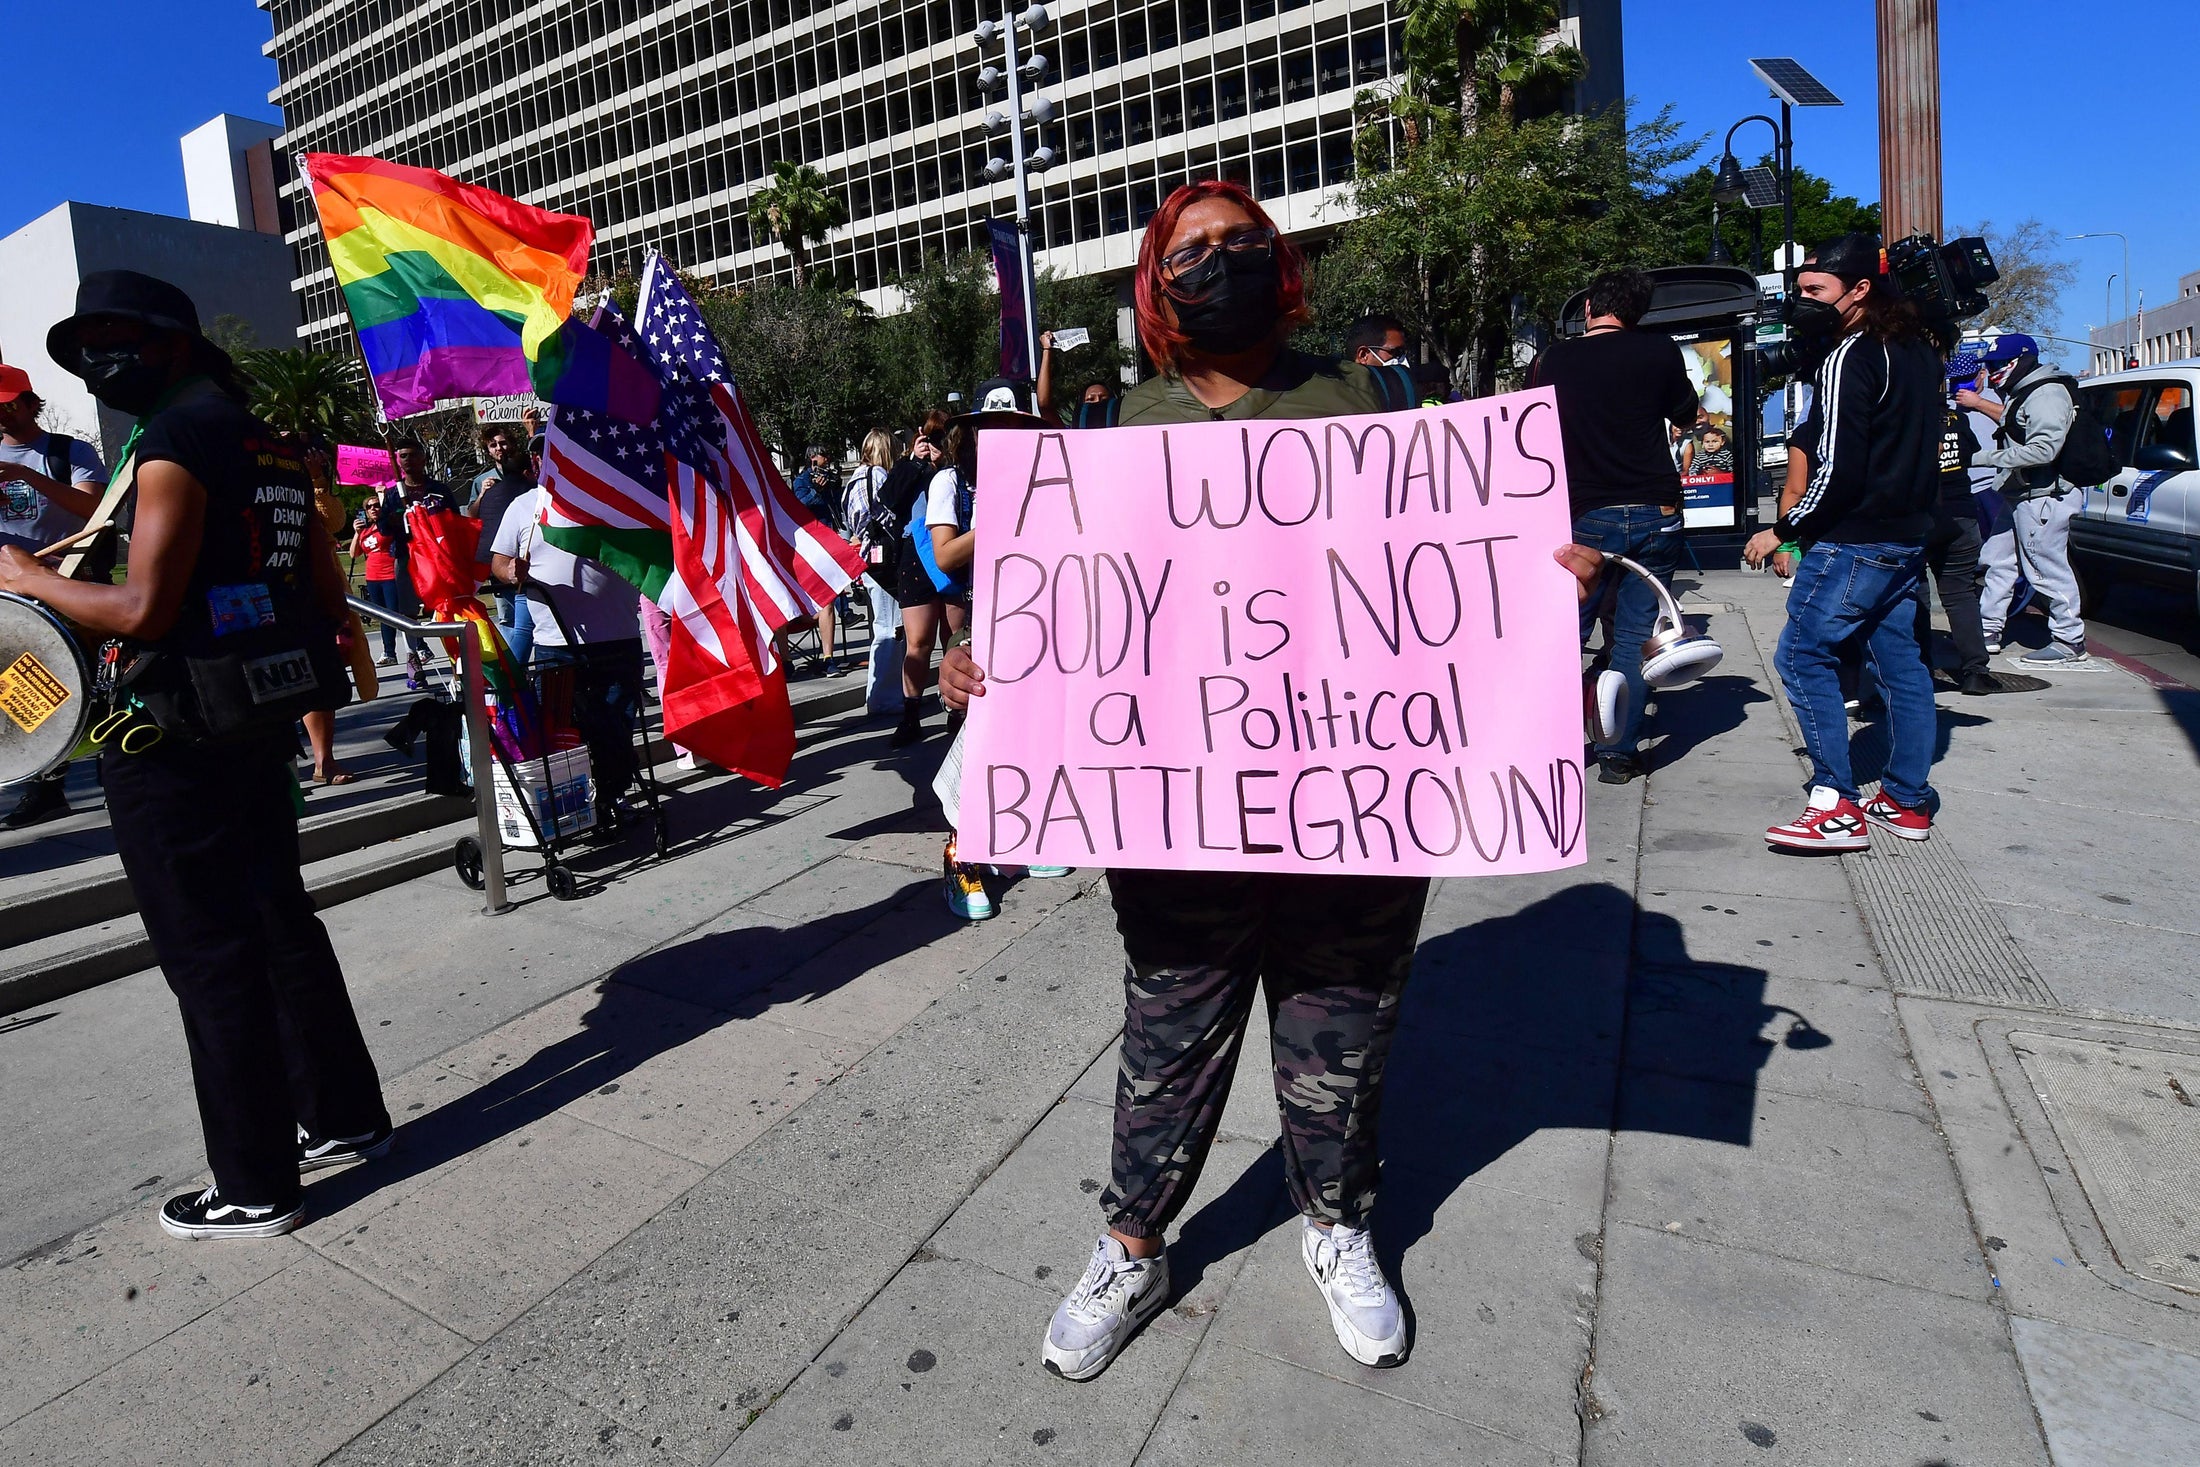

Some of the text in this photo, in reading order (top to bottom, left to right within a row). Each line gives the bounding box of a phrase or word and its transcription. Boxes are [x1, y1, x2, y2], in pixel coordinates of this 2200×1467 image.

[257, 453, 273, 466] NO
[1013, 401, 1556, 538] A WOMAN'S
[1689, 476, 1714, 484] ONLY!
[986, 534, 1519, 685] BODY is NOT
[15, 662, 60, 704] NO SURRENDER!
[21, 656, 33, 667] NO
[31, 665, 51, 684] GOING
[252, 656, 312, 694] NO!
[8, 672, 52, 711] ABORTION ON
[9, 693, 41, 721] WITHOUT
[12, 686, 40, 712] DEMAND
[1088, 662, 1469, 756] a Political
[986, 758, 1585, 865] BATTLEGROUND
